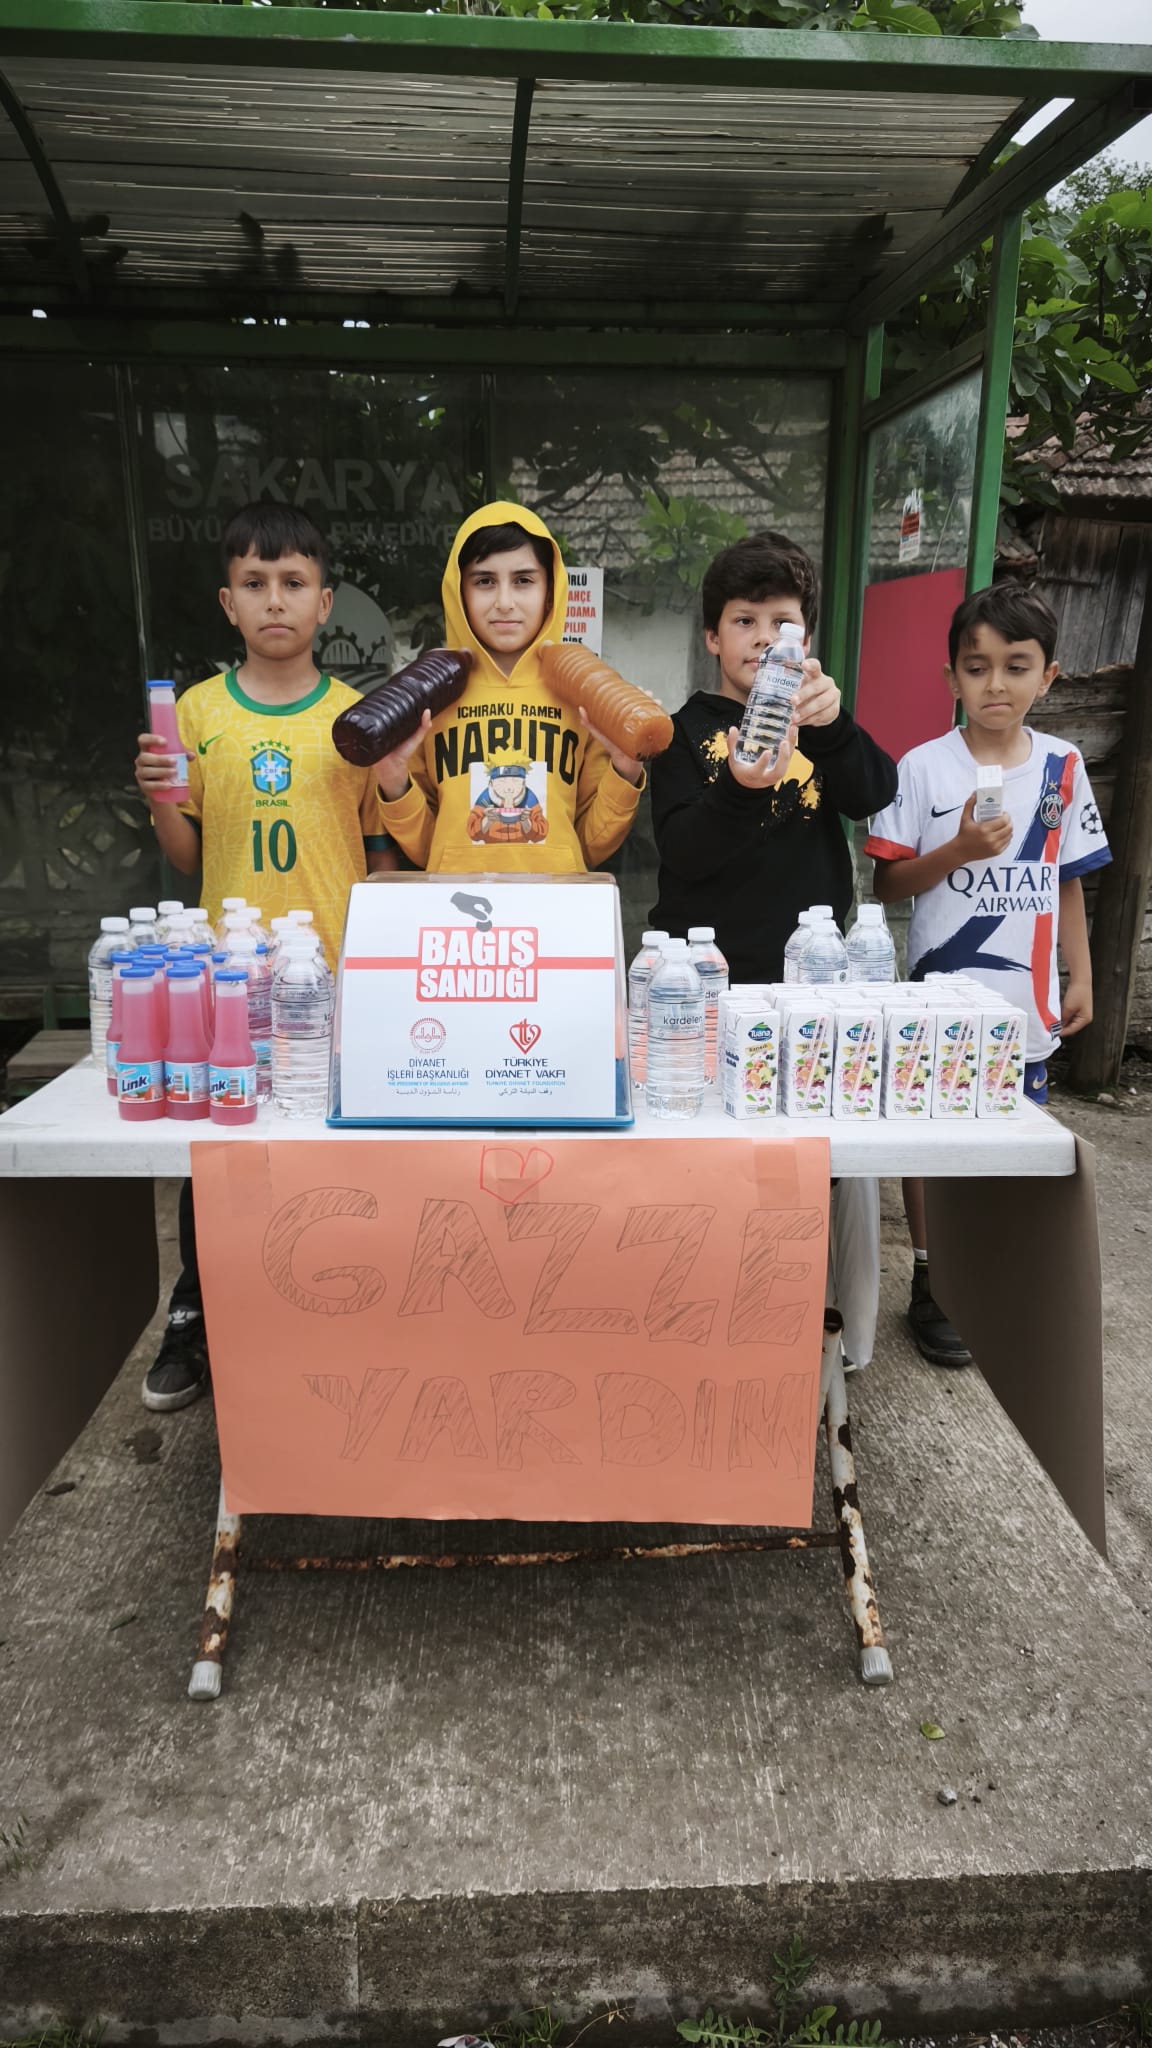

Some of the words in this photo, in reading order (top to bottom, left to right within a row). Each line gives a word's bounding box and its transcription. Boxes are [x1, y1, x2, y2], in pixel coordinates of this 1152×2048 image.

[165, 454, 464, 513] SAKARYA
[330, 519, 458, 547] BELEDİYE
[568, 590, 591, 604] AHÇE
[564, 622, 587, 633] PILIR
[458, 703, 514, 719] ICHIRAKU
[521, 704, 562, 720] RAMEN
[434, 718, 579, 786] NARUTO
[255, 799, 291, 808] BRASIL
[252, 818, 297, 873] 10
[947, 866, 1052, 899] QATAR
[975, 896, 1053, 912] AIRWAYS
[663, 1015, 703, 1026] kardelen
[121, 1075, 148, 1092] Link
[262, 1186, 825, 1346] GAZZE
[302, 1368, 815, 1479] YARDIM
